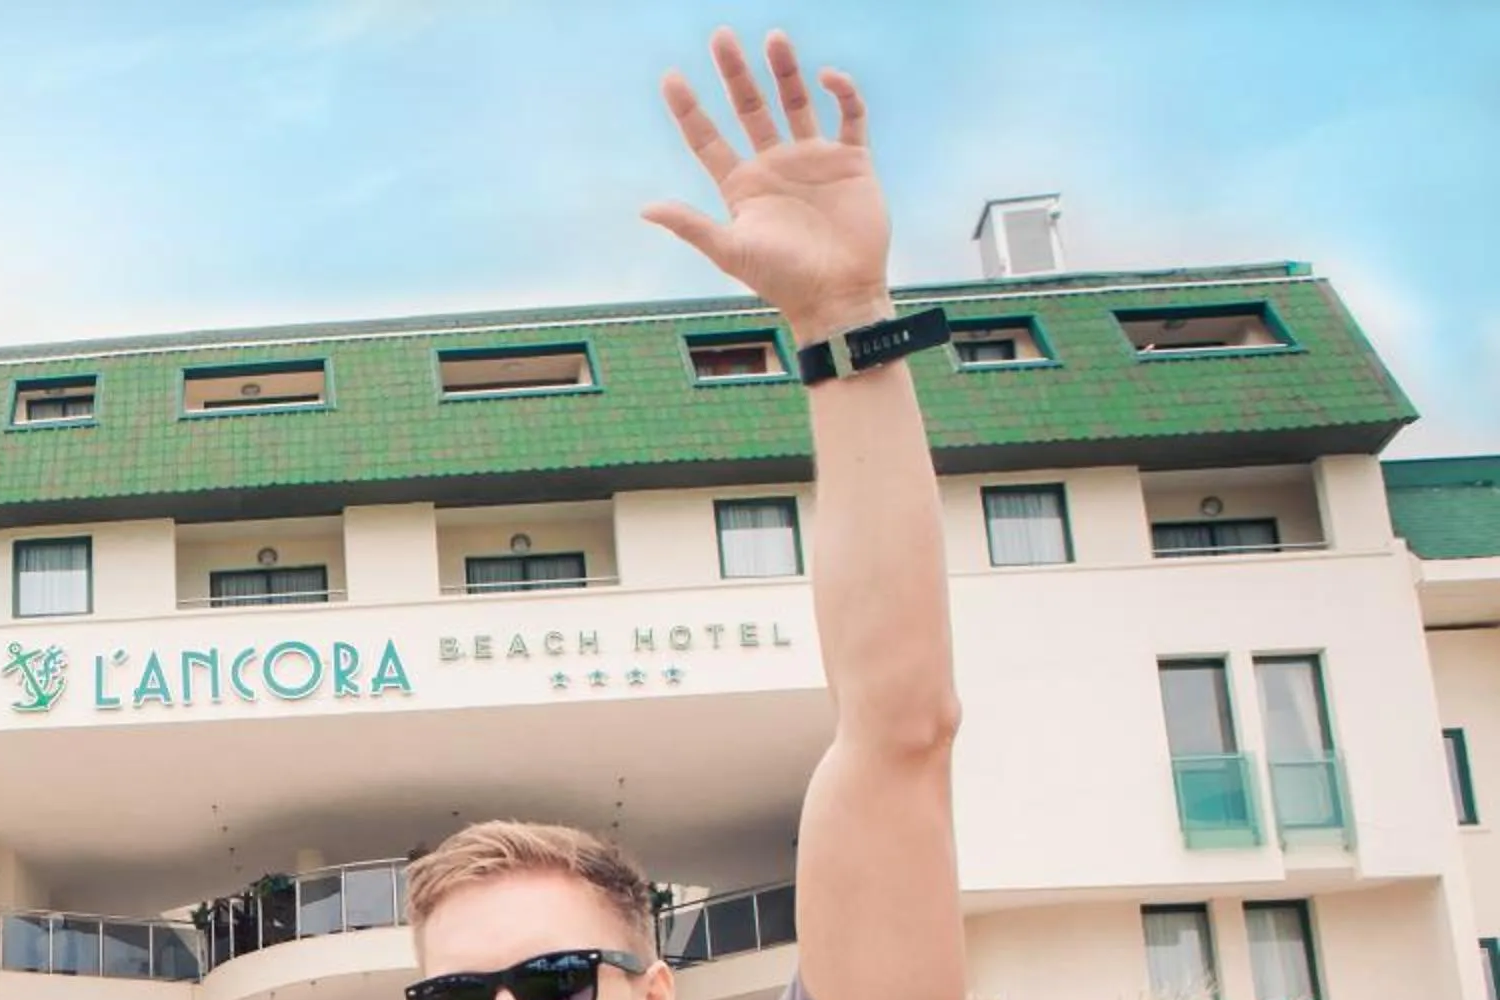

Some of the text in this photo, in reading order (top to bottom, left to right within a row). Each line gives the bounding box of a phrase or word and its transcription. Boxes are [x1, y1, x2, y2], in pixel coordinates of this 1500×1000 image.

[94, 622, 792, 709] L'ANCORA BEACH HOTEL
